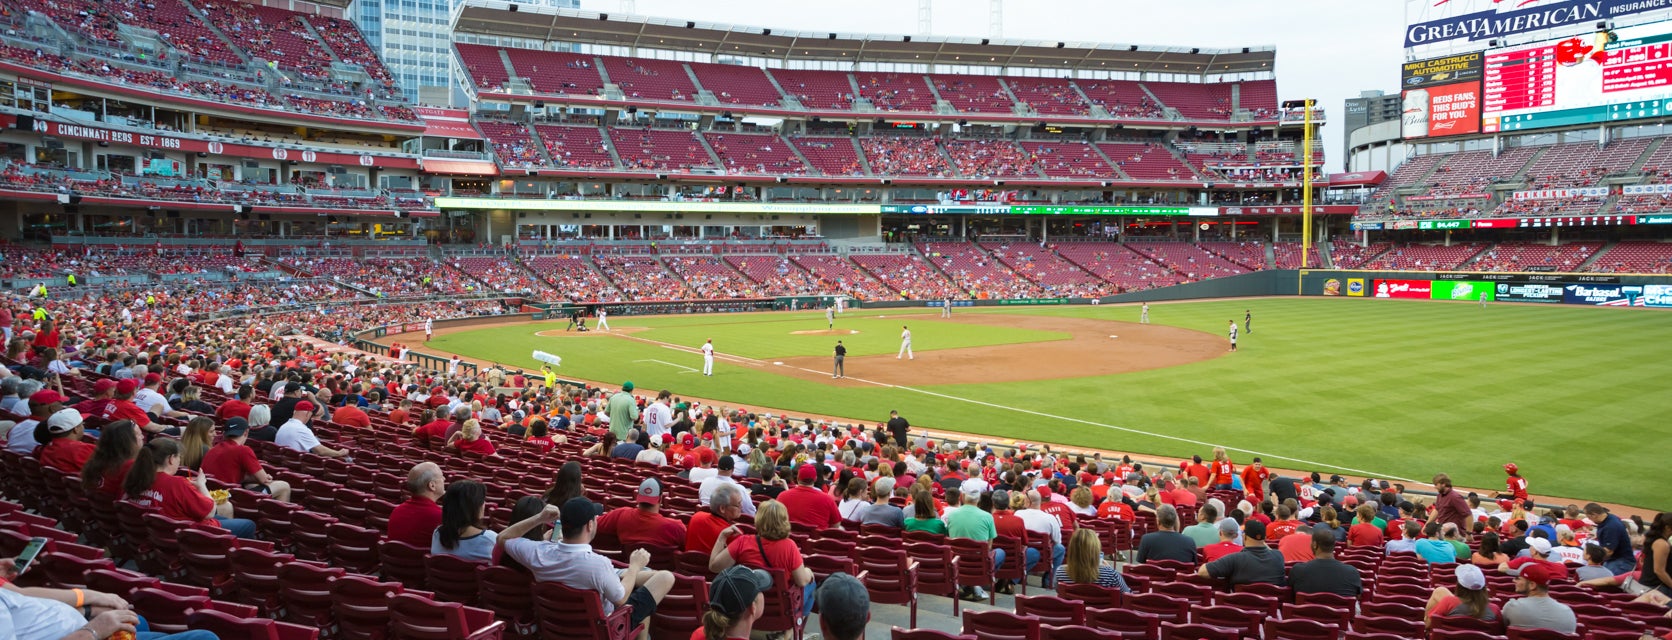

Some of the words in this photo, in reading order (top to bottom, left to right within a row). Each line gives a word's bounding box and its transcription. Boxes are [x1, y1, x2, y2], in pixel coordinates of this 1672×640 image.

[1408, 18, 1482, 43] GREAT
[1473, 2, 1602, 38] AMERICAN
[1609, 0, 1665, 14] INSURANCE
[1404, 61, 1425, 71] MIKE
[1427, 53, 1479, 67] CASTRUCCI
[1413, 61, 1469, 76] AUTOMOTIVE
[1432, 95, 1453, 105] REDS
[1454, 91, 1476, 102] FANS,
[1432, 104, 1451, 113] THIS
[1451, 100, 1476, 111] BUD'S
[1638, 109, 1645, 117] 0
[1652, 108, 1659, 116] 3
[1432, 112, 1448, 121] FOR
[1449, 109, 1467, 119] YOU.
[58, 124, 109, 140] CINCINNATI
[112, 131, 133, 144] REDS
[139, 135, 159, 147] EST.
[161, 138, 181, 149] 1869
[275, 149, 285, 159] 13
[305, 151, 314, 161] 11
[649, 412, 657, 424] 19
[1221, 464, 1230, 474] 19
